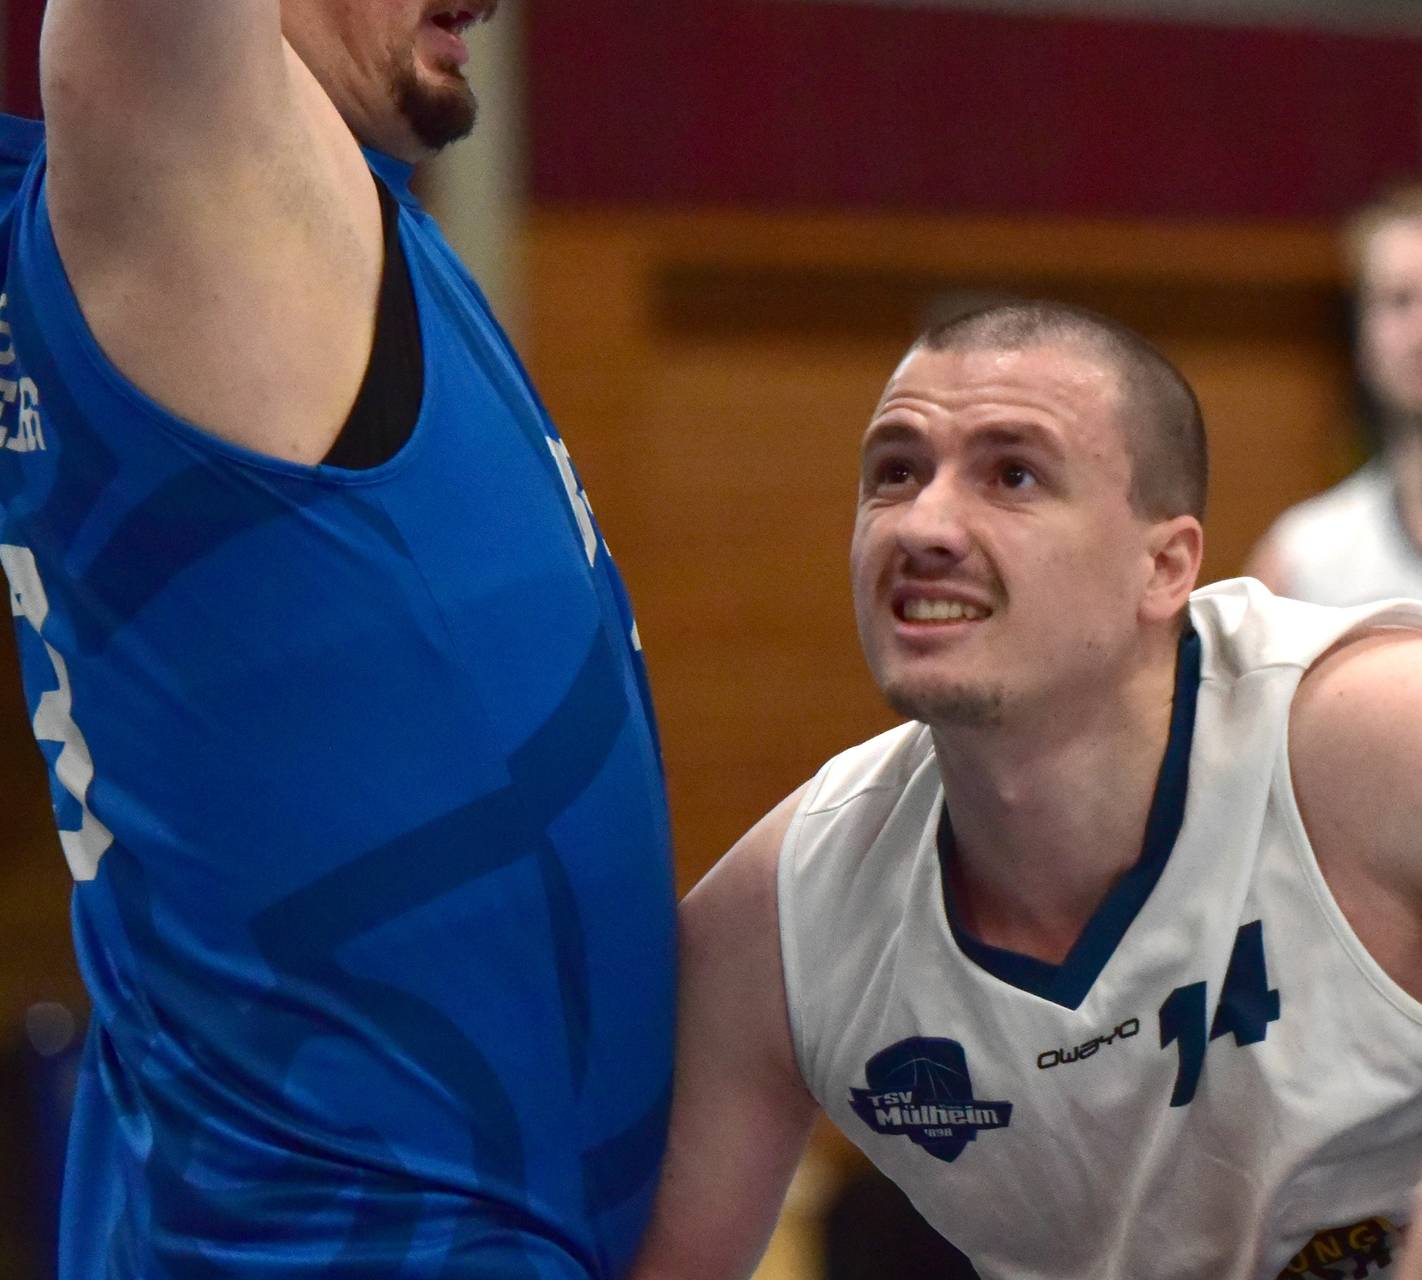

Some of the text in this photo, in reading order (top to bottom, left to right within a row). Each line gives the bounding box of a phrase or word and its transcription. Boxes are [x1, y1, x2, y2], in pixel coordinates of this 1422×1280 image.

[1159, 919, 1281, 1107] 14
[868, 1091, 913, 1107] TSV
[875, 1104, 999, 1126] Mülheim
